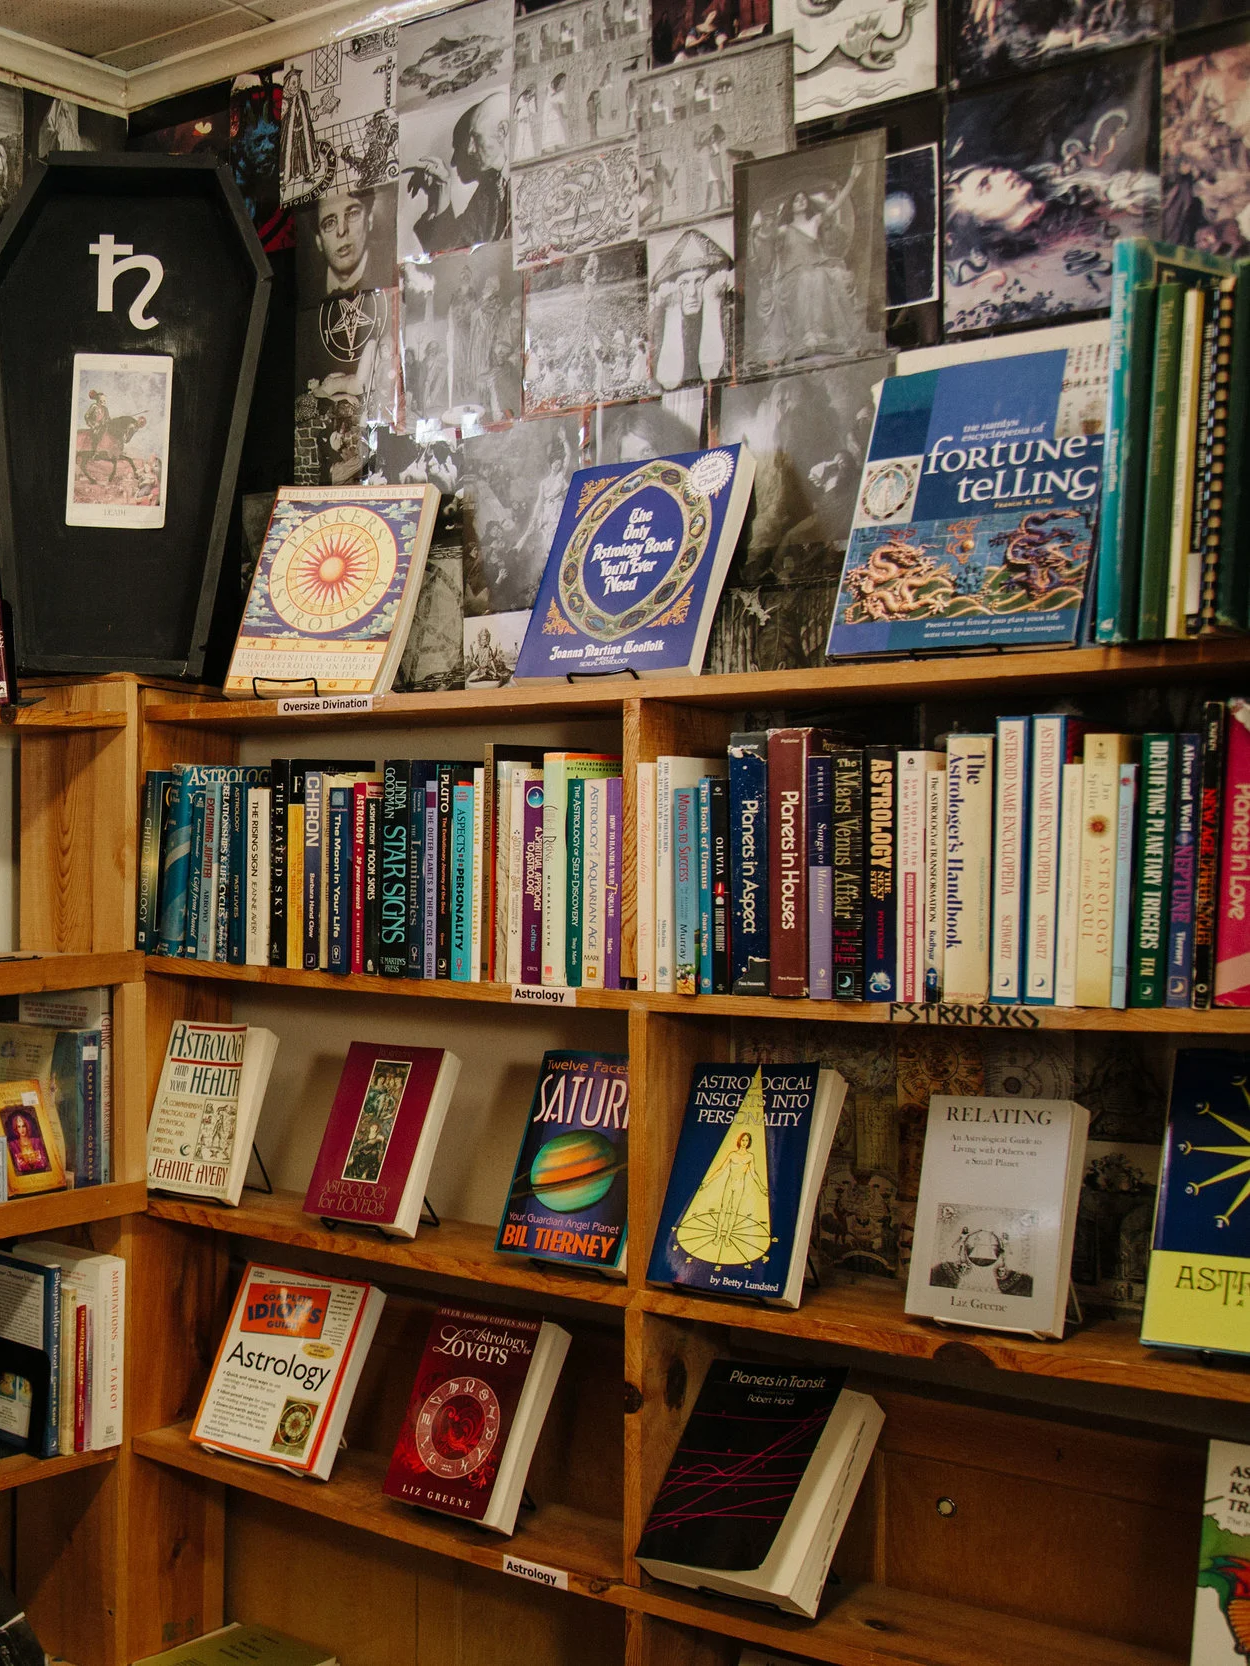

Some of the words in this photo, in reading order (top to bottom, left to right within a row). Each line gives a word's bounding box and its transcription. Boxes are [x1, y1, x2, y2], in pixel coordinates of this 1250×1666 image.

[629, 508, 653, 524] The
[623, 524, 650, 541] Only
[590, 541, 644, 563] Astrology
[644, 537, 676, 554] Book
[600, 560, 629, 577] You'll
[629, 557, 657, 574] Ever
[603, 576, 637, 597] Need
[271, 571, 388, 631] ASTROLOGY
[549, 645, 584, 662] Joanna
[584, 643, 622, 658] Martine
[283, 700, 320, 712] Oversize
[322, 699, 368, 710] Divination
[966, 750, 986, 785] The
[275, 783, 284, 815] THE
[440, 774, 449, 814] PLUTO
[946, 752, 965, 854] Astrologer's
[305, 776, 320, 847] CHIRON
[781, 790, 800, 850] Planets
[870, 758, 893, 870] ASTROLOGY
[455, 808, 466, 854] ASPECTS
[742, 800, 759, 858] Planets
[275, 824, 284, 878] FATED
[384, 825, 407, 876] STAR
[781, 852, 798, 868] in
[334, 874, 340, 884] in
[742, 861, 758, 876] in
[273, 886, 283, 918] SKY
[333, 886, 341, 914] Your
[381, 880, 405, 944] SIGNS
[455, 868, 465, 951] PERSONALITY
[739, 879, 760, 934] Aspect
[780, 871, 800, 930] Houses
[946, 859, 964, 949] Handbook
[514, 987, 565, 1003] Astrology
[548, 1060, 589, 1072] Twelve
[189, 1067, 240, 1097] HEALTH
[697, 1075, 812, 1091] ASTROLOGICAL
[695, 1092, 767, 1107] INSIGHTS
[771, 1094, 810, 1108] INTO
[697, 1109, 802, 1127] PERSONALITY
[946, 1106, 1052, 1126] RELATING
[150, 1159, 194, 1182] JEANNE
[195, 1164, 229, 1186] AVERY
[509, 1212, 525, 1221] Your
[527, 1213, 564, 1226] Guardian
[565, 1218, 590, 1231] Angel
[592, 1222, 620, 1235] Planet
[502, 1223, 529, 1247] BIL
[535, 1227, 616, 1259] TIERNEY
[709, 1275, 721, 1285] by
[722, 1277, 743, 1289] Betty
[744, 1279, 779, 1292] Lundsted
[950, 1297, 967, 1309] Liz
[970, 1299, 1008, 1313] Greene
[226, 1340, 331, 1392] Astrology
[729, 1370, 776, 1388] Planets
[777, 1374, 789, 1388] in
[790, 1375, 826, 1389] Transit
[402, 1483, 422, 1497] LIZ
[427, 1489, 472, 1510] GREENE
[506, 1560, 557, 1585] Astrology
